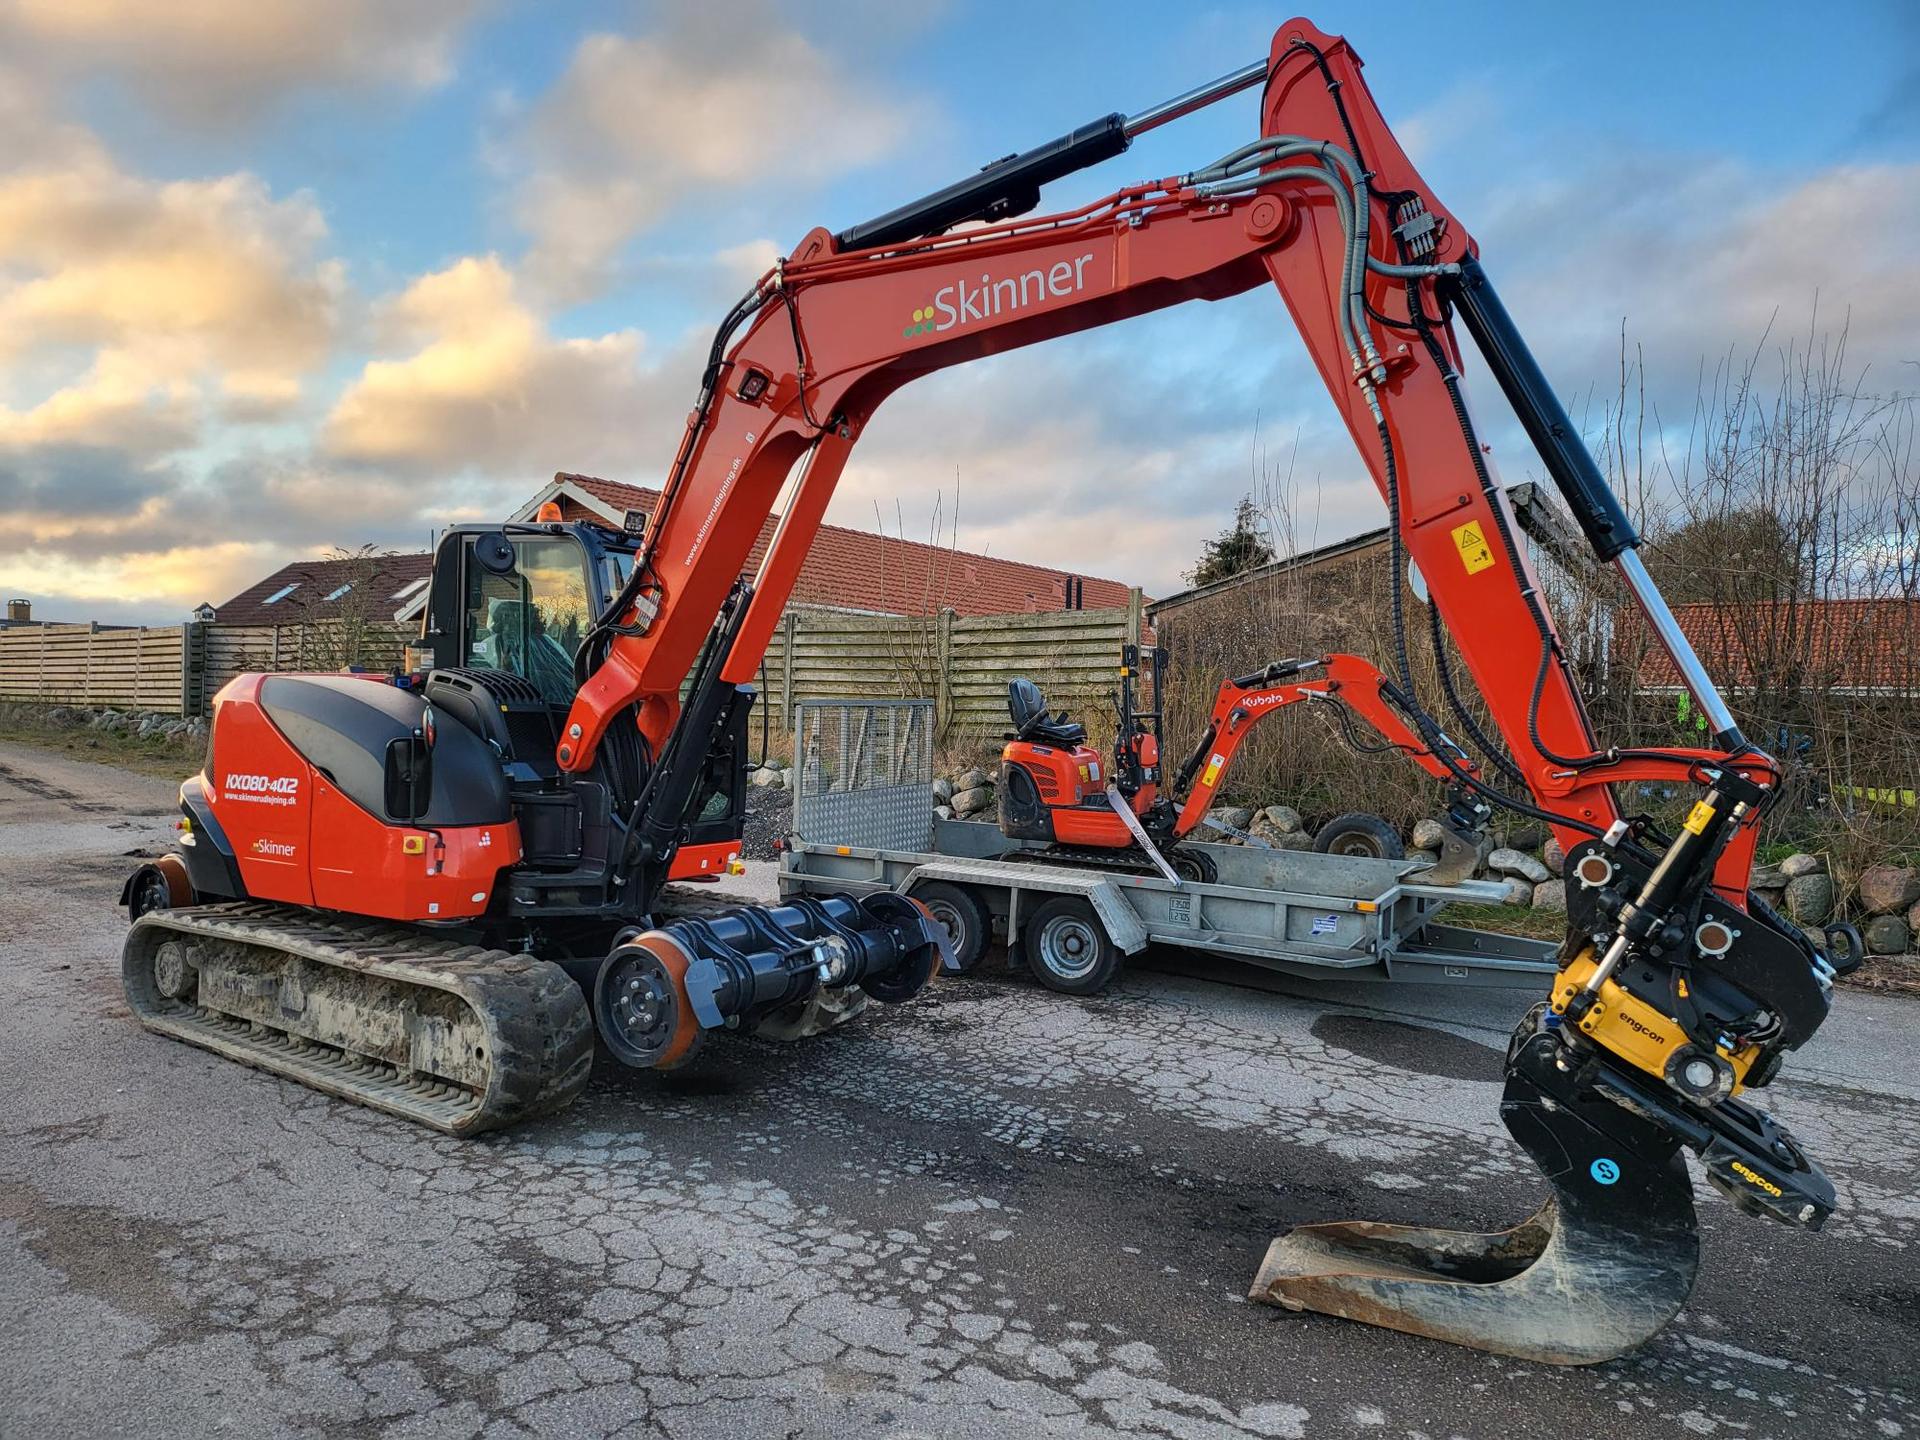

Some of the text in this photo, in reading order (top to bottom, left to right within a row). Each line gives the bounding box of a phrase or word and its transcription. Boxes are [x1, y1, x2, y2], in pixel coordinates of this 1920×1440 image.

[935, 254, 1093, 331] Skinner
[684, 456, 742, 567] www.skinnerudlejning.dk
[1242, 694, 1283, 707] Kubota
[224, 792, 296, 806] www.skinnerudlejning.dk
[258, 838, 296, 857] Skinner
[1620, 1012, 1665, 1044] engcon
[1731, 1161, 1782, 1197] engcon
